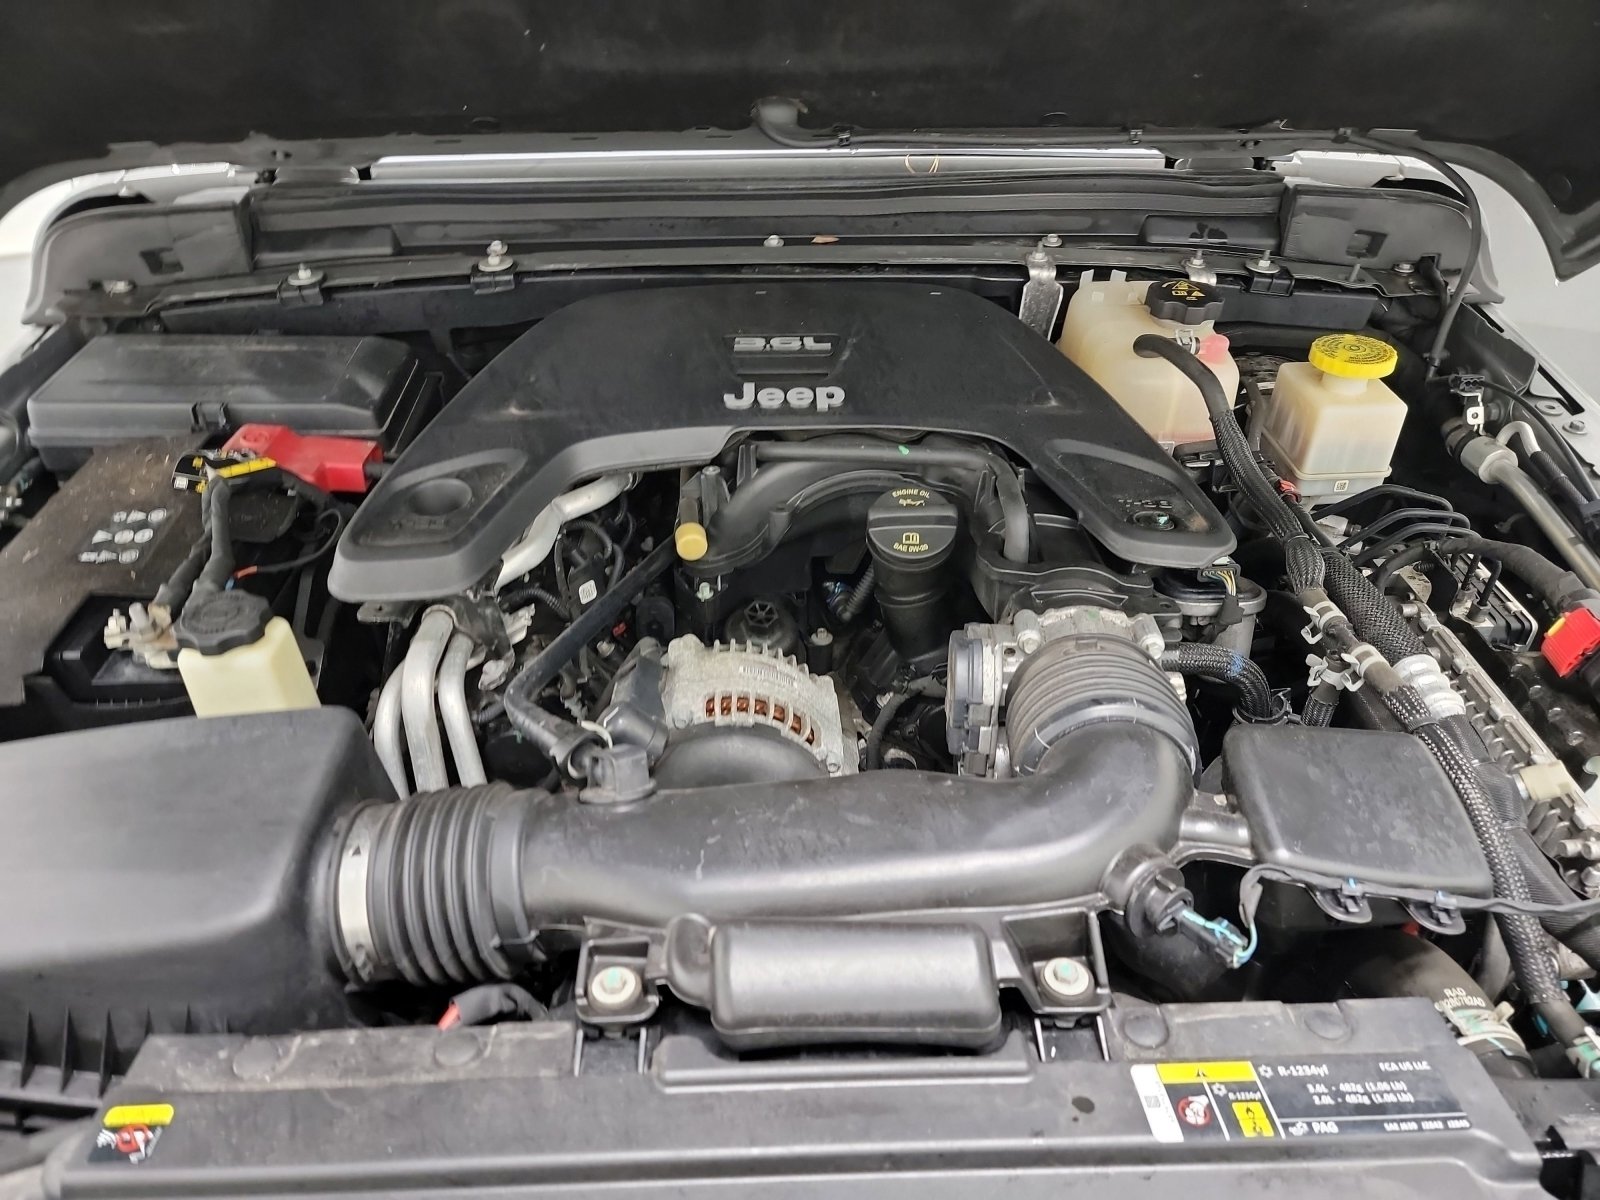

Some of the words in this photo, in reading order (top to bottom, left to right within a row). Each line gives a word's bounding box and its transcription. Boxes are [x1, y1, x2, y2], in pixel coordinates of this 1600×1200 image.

[734, 336, 832, 352] 3.6L
[723, 382, 845, 412] Jeep
[892, 488, 919, 498] ENGINE
[919, 490, 930, 499] OIL
[1443, 986, 1467, 998] RAD
[1277, 1063, 1329, 1078] R-1234yf
[1379, 1062, 1399, 1073] FCA
[1399, 1061, 1413, 1072] US
[1412, 1060, 1432, 1071] LLC
[1228, 1091, 1262, 1102] R-1234yf
[1311, 1121, 1339, 1135] PAG
